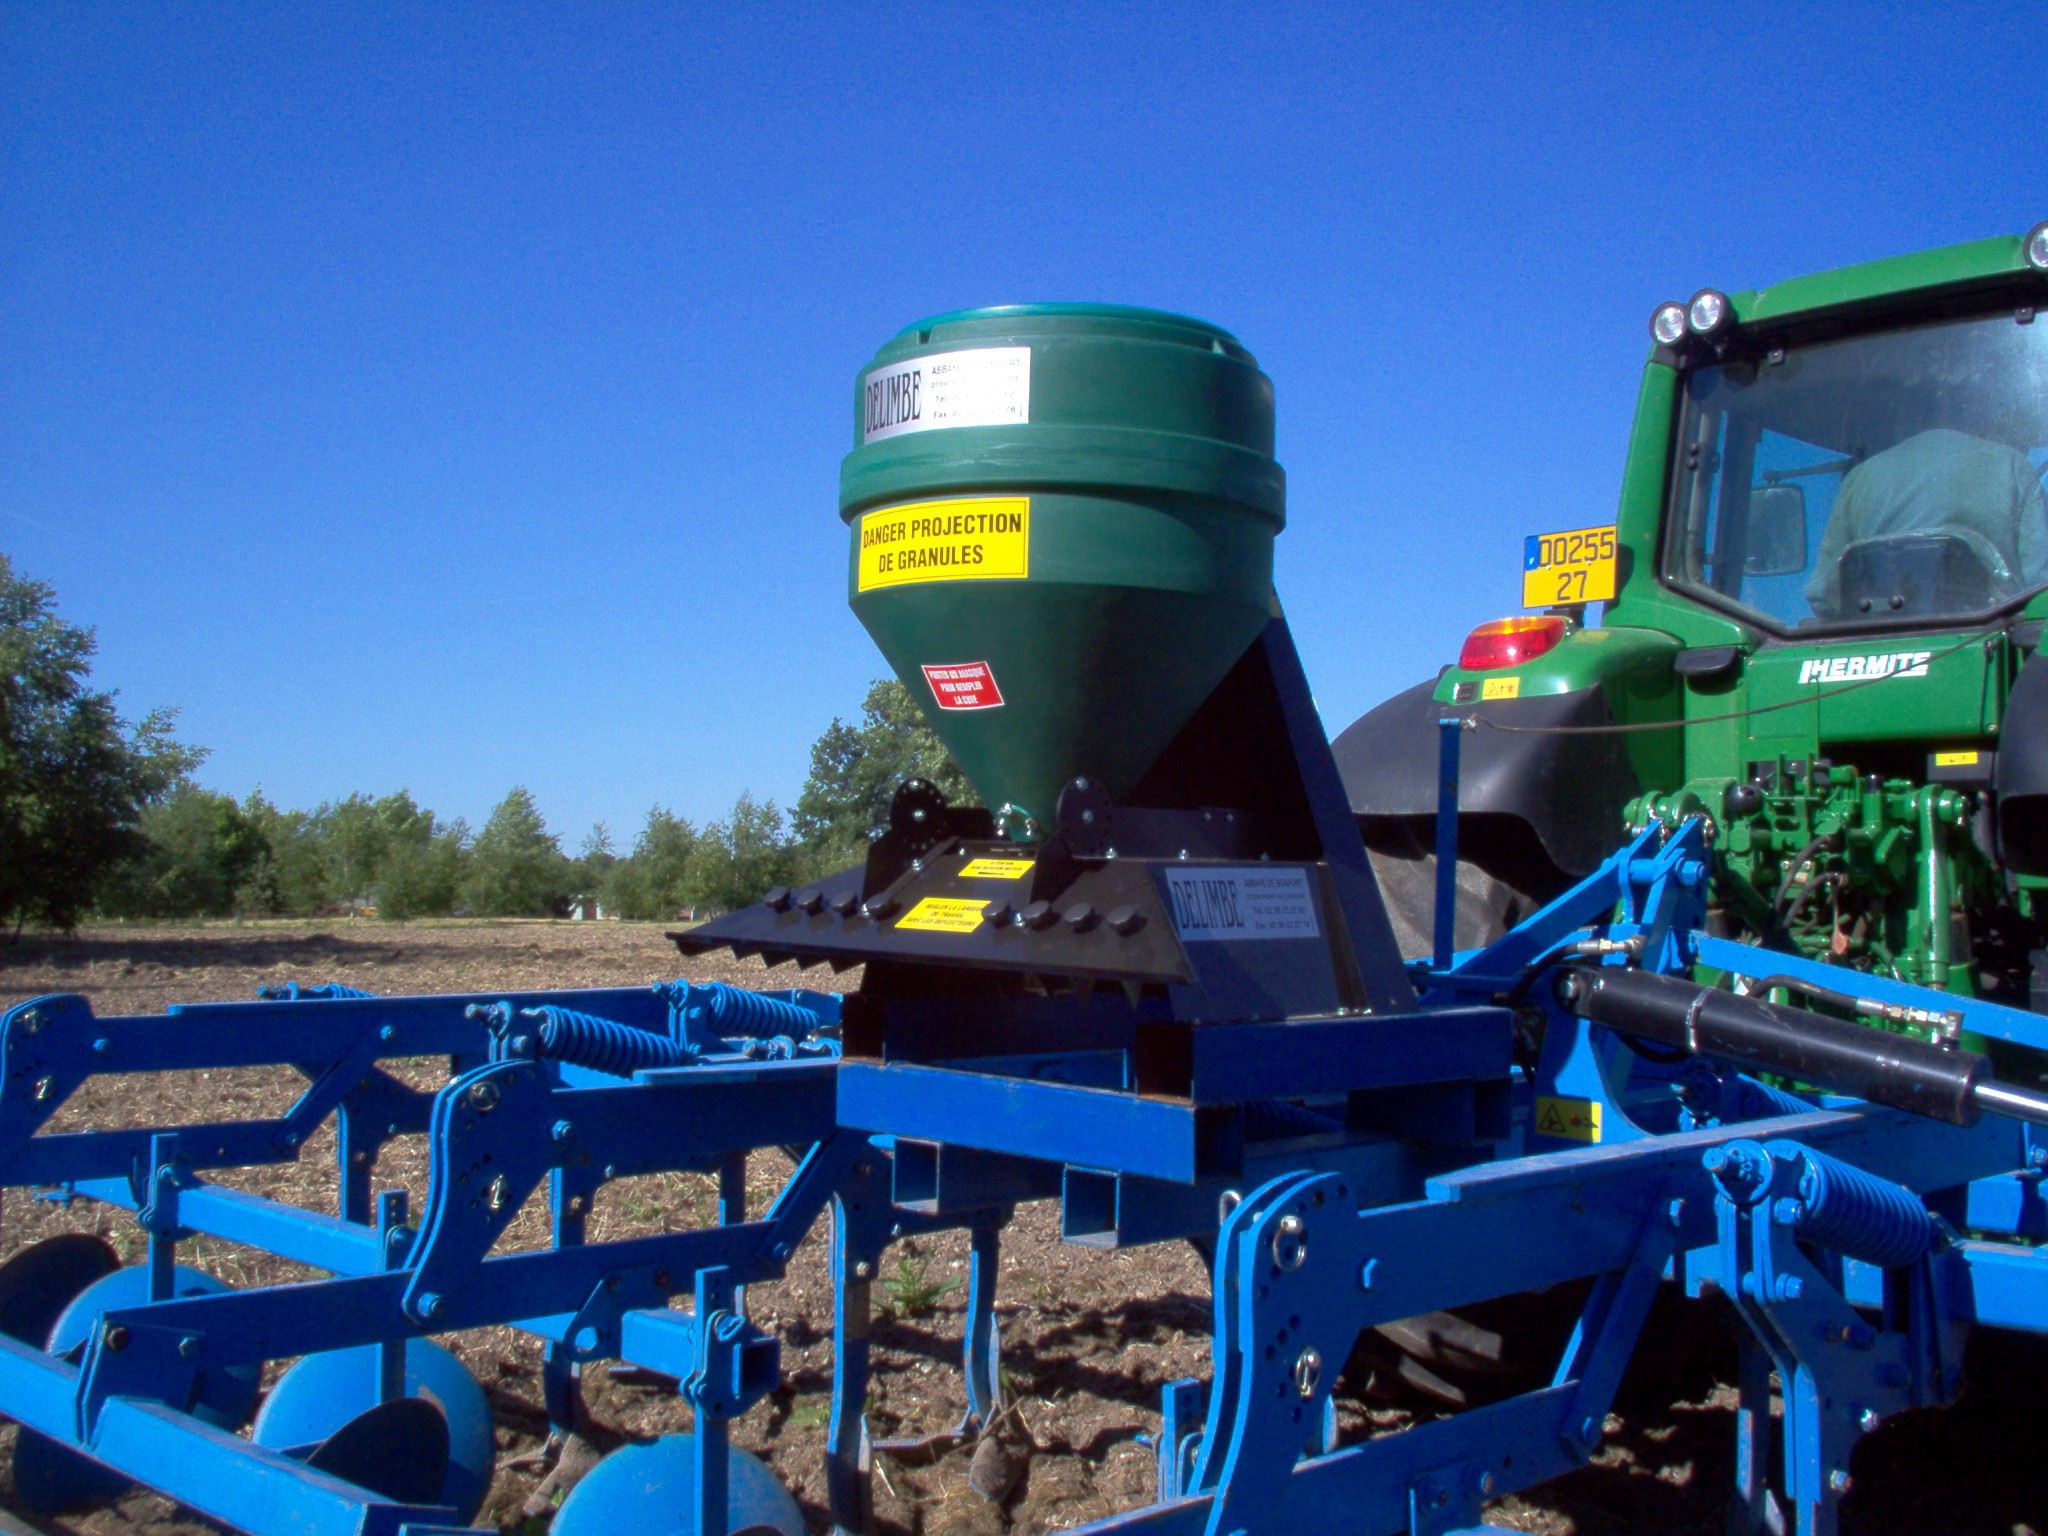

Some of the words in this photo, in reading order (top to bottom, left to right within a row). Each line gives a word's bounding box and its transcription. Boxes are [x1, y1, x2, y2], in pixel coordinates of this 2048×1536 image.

[866, 370, 921, 434] DELIMBE
[863, 522, 906, 548] DANGER
[911, 513, 1022, 539] PROJECTION
[879, 554, 894, 573] DE
[898, 544, 984, 570] GRANULES
[1557, 570, 1587, 601] 27
[1172, 880, 1245, 929] DELIMBE
